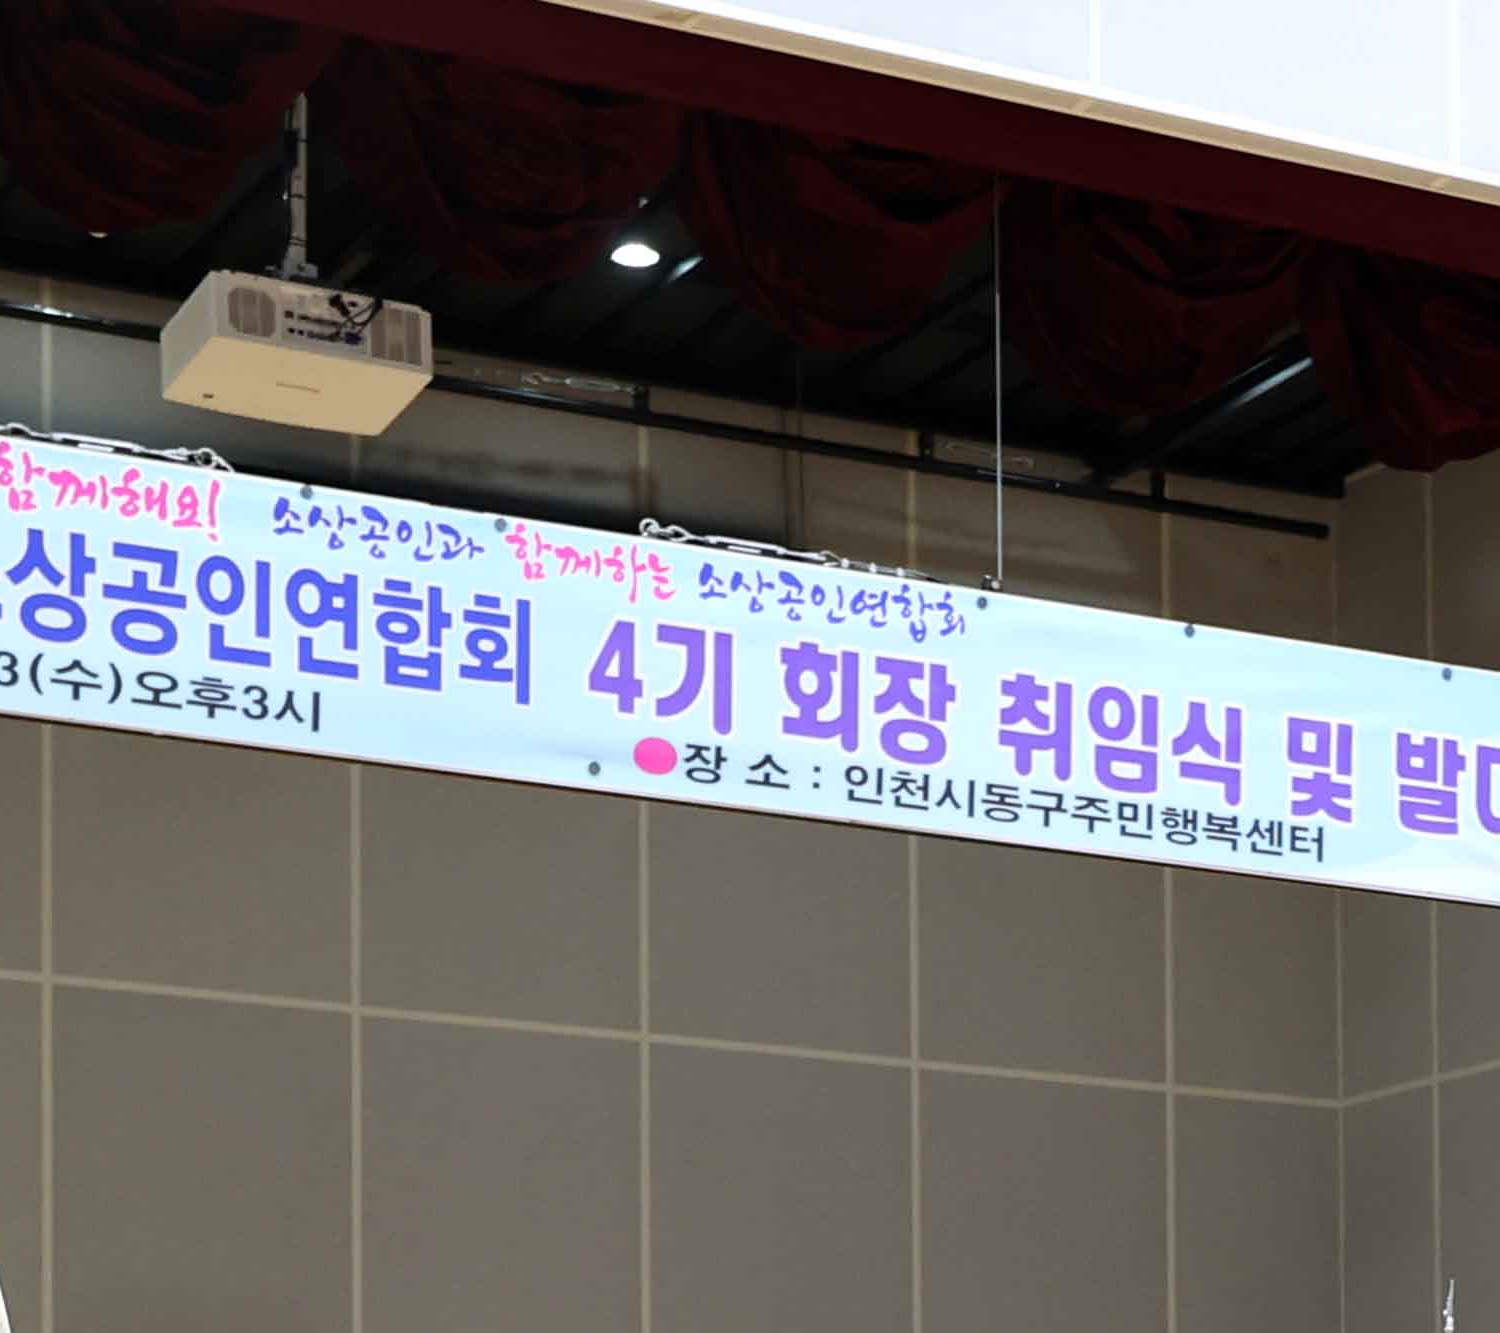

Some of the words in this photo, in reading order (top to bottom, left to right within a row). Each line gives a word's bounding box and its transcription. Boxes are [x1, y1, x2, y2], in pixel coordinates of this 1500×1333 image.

[272, 497, 485, 562] 소상공인과
[505, 523, 676, 602] 함께하는
[699, 561, 967, 643] 소상공인연합회
[588, 620, 734, 735] 4기
[779, 642, 956, 766] 회장
[998, 672, 1243, 806] 취임식
[1284, 714, 1354, 824] 및
[843, 762, 1326, 863] 인천시동구주민행복센터
